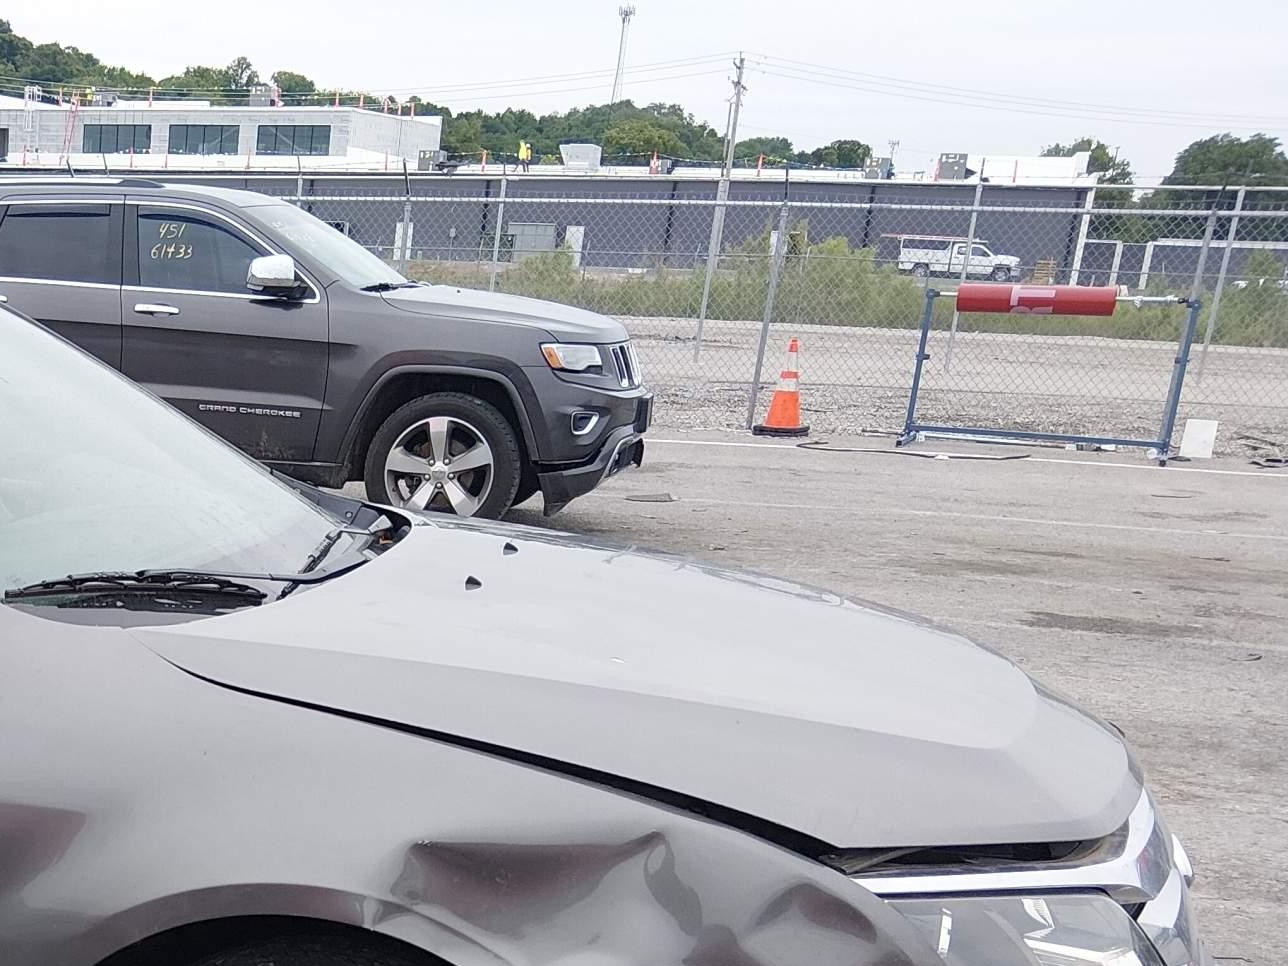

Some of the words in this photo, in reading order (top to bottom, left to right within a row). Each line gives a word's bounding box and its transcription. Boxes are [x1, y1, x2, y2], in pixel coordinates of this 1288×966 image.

[159, 223, 186, 239] 451
[151, 243, 192, 259] 61433
[198, 403, 237, 413] GRAND
[239, 406, 301, 418] CHEROKEE
